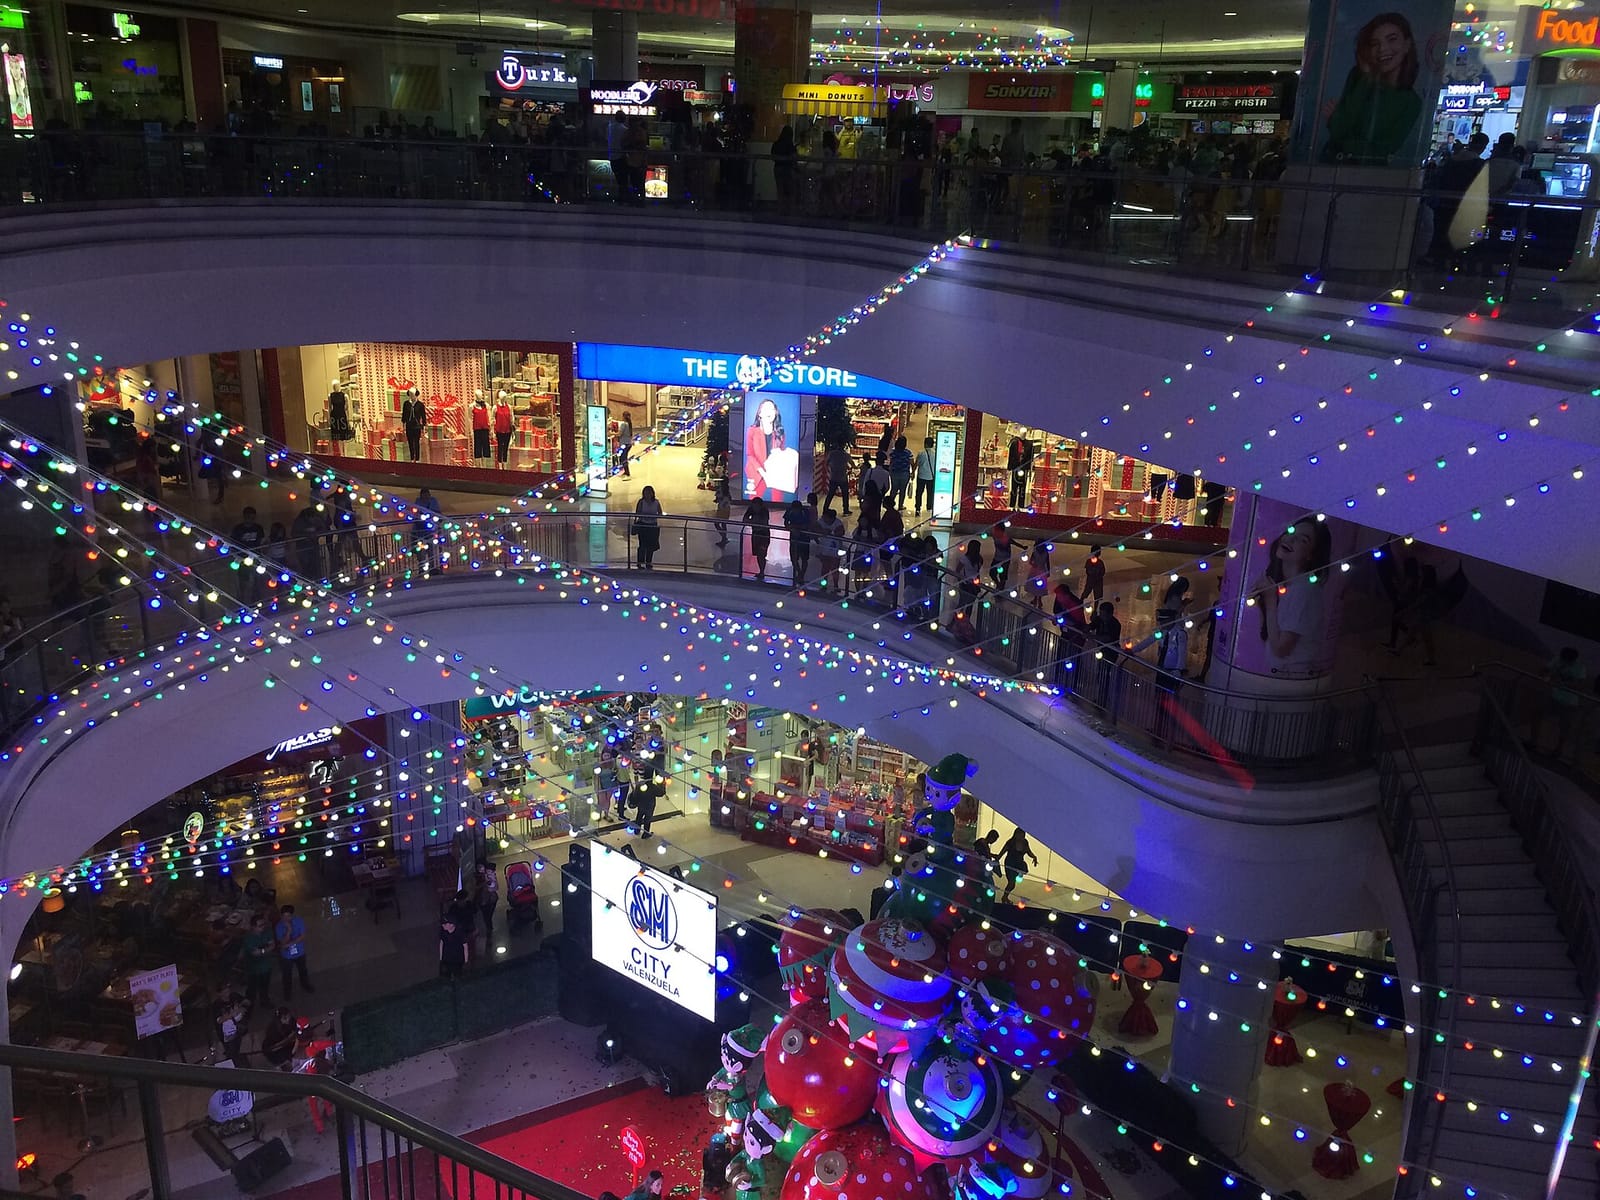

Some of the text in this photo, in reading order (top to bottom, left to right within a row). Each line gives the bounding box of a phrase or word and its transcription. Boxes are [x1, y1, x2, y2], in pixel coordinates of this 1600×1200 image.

[1537, 10, 1599, 45] Food
[798, 91, 865, 101] MINI DONUTS
[1185, 99, 1268, 108] PIZZA PASTA
[683, 358, 727, 378] THE
[778, 363, 858, 388] STORE
[630, 879, 669, 944] SM
[622, 960, 680, 997] VALENZUELA
[631, 947, 671, 979] CITY
[222, 1106, 241, 1116] CITY
